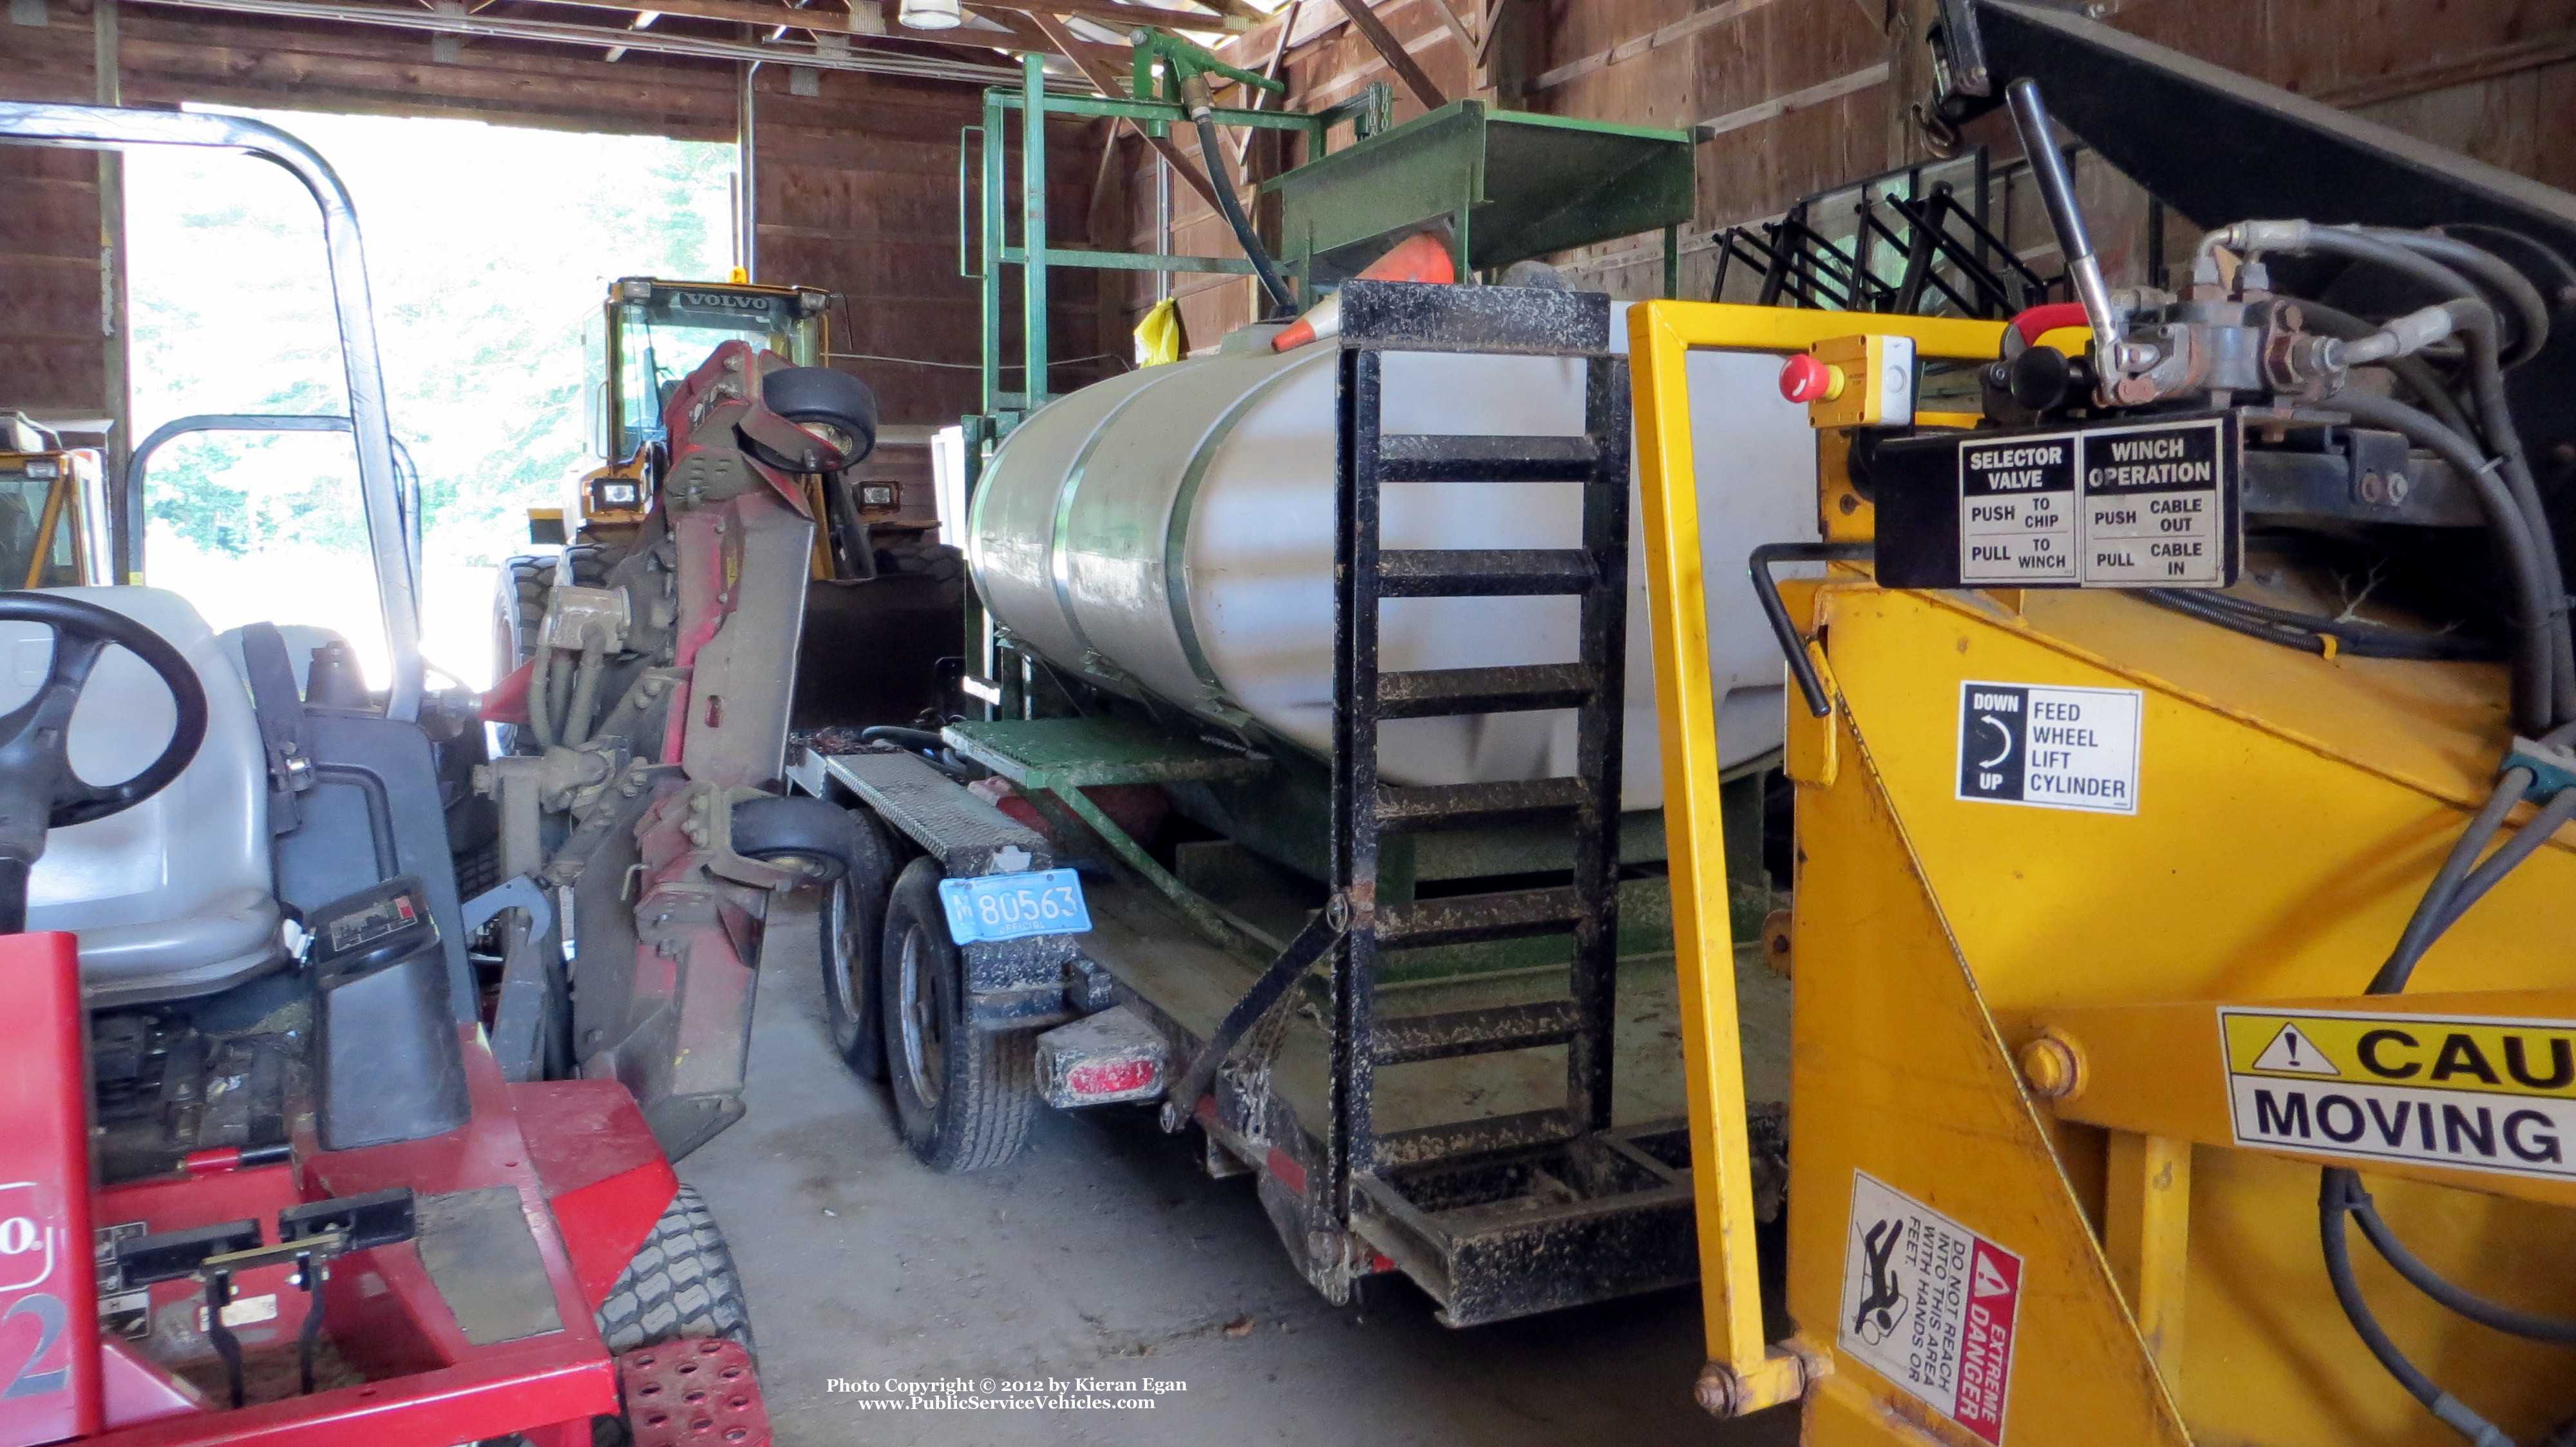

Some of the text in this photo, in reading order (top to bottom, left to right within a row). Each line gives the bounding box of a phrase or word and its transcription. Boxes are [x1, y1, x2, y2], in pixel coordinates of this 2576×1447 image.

[685, 294, 768, 310] VOLVO
[1970, 447, 2062, 470] SELECTOR
[2112, 438, 2184, 462] WINCH
[1987, 469, 2043, 490] VALVE
[2088, 461, 2211, 487] OPERATION
[1971, 505, 2015, 522] PUSH
[2032, 498, 2050, 511] TO
[2150, 498, 2202, 515] CABLE
[2025, 515, 2059, 528] CHIP
[2094, 511, 2137, 525] PUSH
[2160, 518, 2192, 532] OUT
[1971, 546, 2011, 561] PULL
[2032, 538, 2050, 551] TO
[2150, 543, 2202, 557] CABLE
[2018, 555, 2066, 569] WINCH
[2097, 554, 2135, 567] PULL
[2168, 562, 2185, 575] IN
[1973, 693, 2019, 712] DOWN
[2034, 702, 2081, 721] FEED
[2033, 726, 2098, 747] WHEEL
[2032, 750, 2071, 769] LIFT
[1979, 773, 2003, 790] UP
[2031, 773, 2125, 798] CYLINDER
[978, 886, 1079, 925] 80563
[999, 921, 1046, 934] OFFICIAL
[2357, 1029, 2575, 1090] CAU
[2254, 1088, 2563, 1164] MOVING
[1904, 1215, 1920, 1267] FEET.
[1909, 1226, 1935, 1383] WITH HANDS OR
[1924, 1232, 1951, 1387] INTO THIS AREA
[1940, 1240, 1965, 1394] DO NOT REACH
[1960, 1304, 1990, 1421] DANGER
[1982, 1325, 2006, 1424] EXTREME
